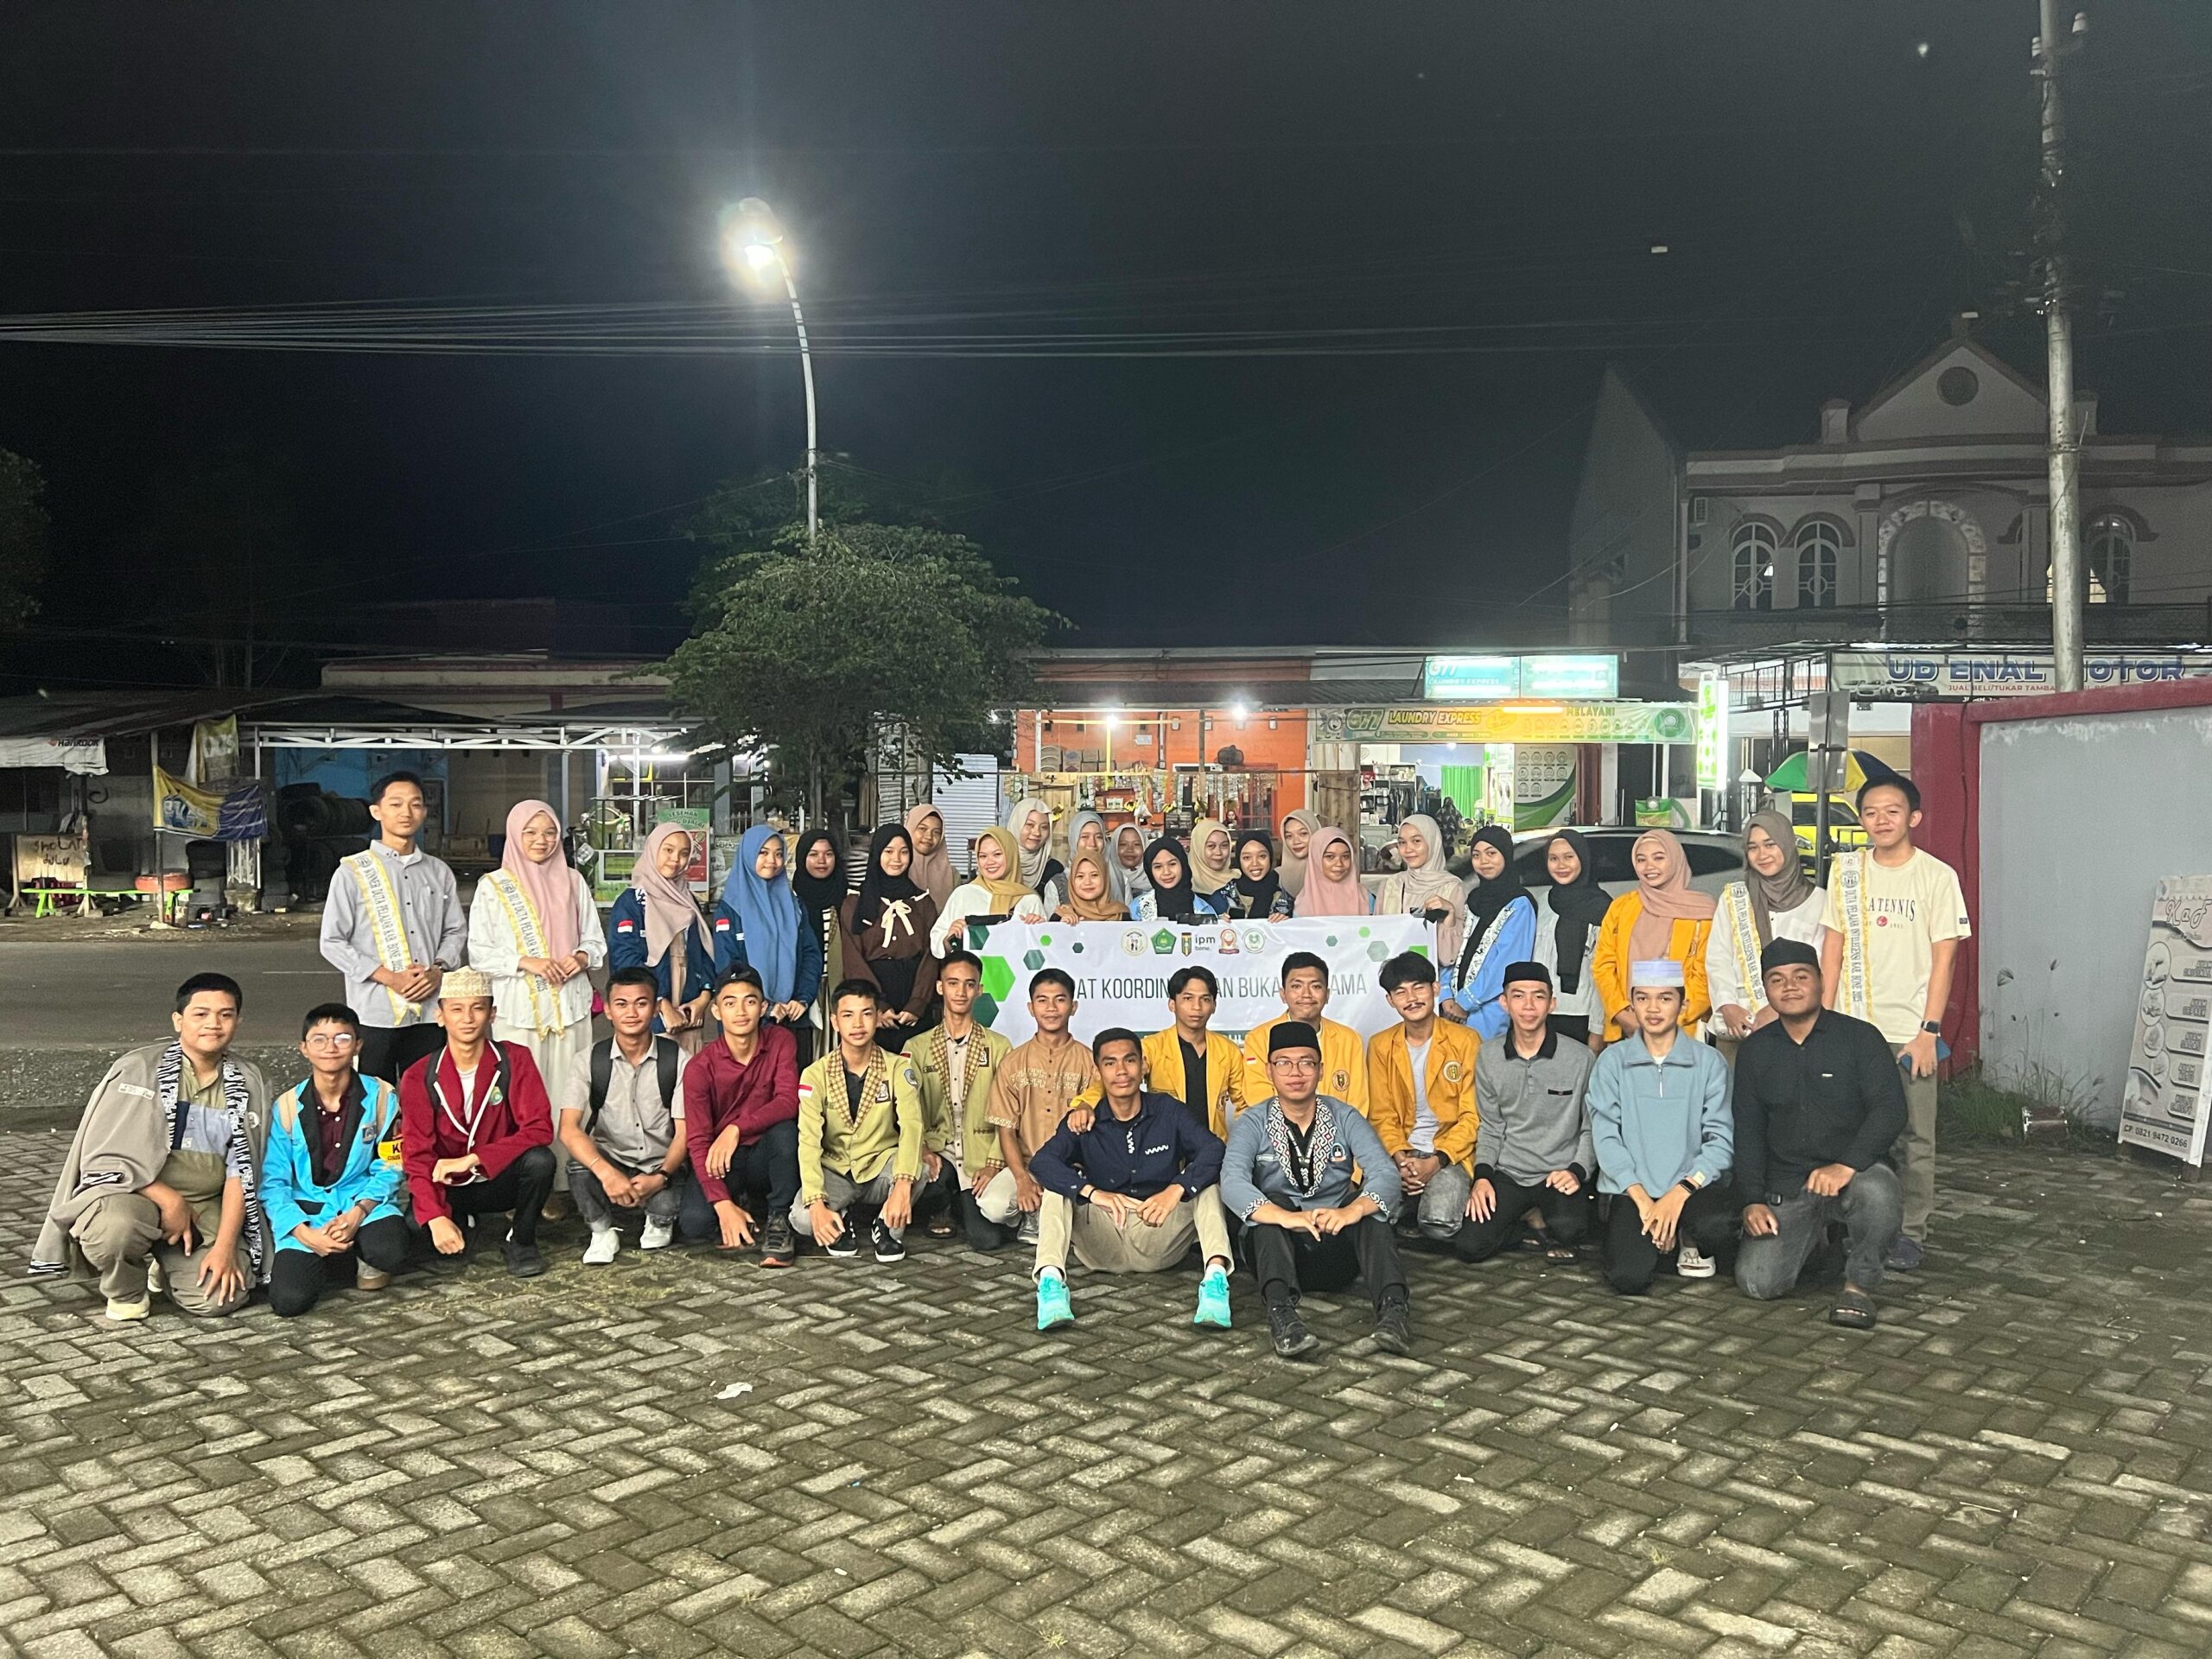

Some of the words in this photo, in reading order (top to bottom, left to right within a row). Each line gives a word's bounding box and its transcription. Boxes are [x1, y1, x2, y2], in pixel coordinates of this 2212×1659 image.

[1888, 659, 1938, 682] UD
[1949, 660, 2046, 683] ENAL
[2083, 658, 2186, 682] OTOR
[1388, 710, 1435, 725] LAUNDRY
[1437, 710, 1482, 725] EXPRESS
[1567, 706, 1615, 716] MELAYANI
[365, 868, 379, 889] WINNER
[372, 887, 385, 905] DUTA
[1845, 889, 1856, 903] DUTA
[1734, 898, 1747, 911] DUTA
[1878, 899, 1915, 922] TENNIS
[377, 904, 393, 929] PELAJAR
[515, 906, 528, 921] DUTA
[1736, 911, 1750, 931] PELAJAR
[1847, 905, 1859, 926] PELAJAR
[520, 922, 537, 947] PELAJAR
[1195, 935, 1215, 946] ipm
[387, 942, 400, 959] BONE
[391, 958, 404, 972] 2025
[537, 978, 548, 992] 2025
[1241, 977, 1281, 998] BUKA
[1749, 973, 1762, 988] BONE
[1851, 975, 1861, 989] BONE
[1852, 990, 1861, 1002] 2025
[2151, 1129, 2170, 1143] 9472
[2170, 1135, 2189, 1148] 0266
